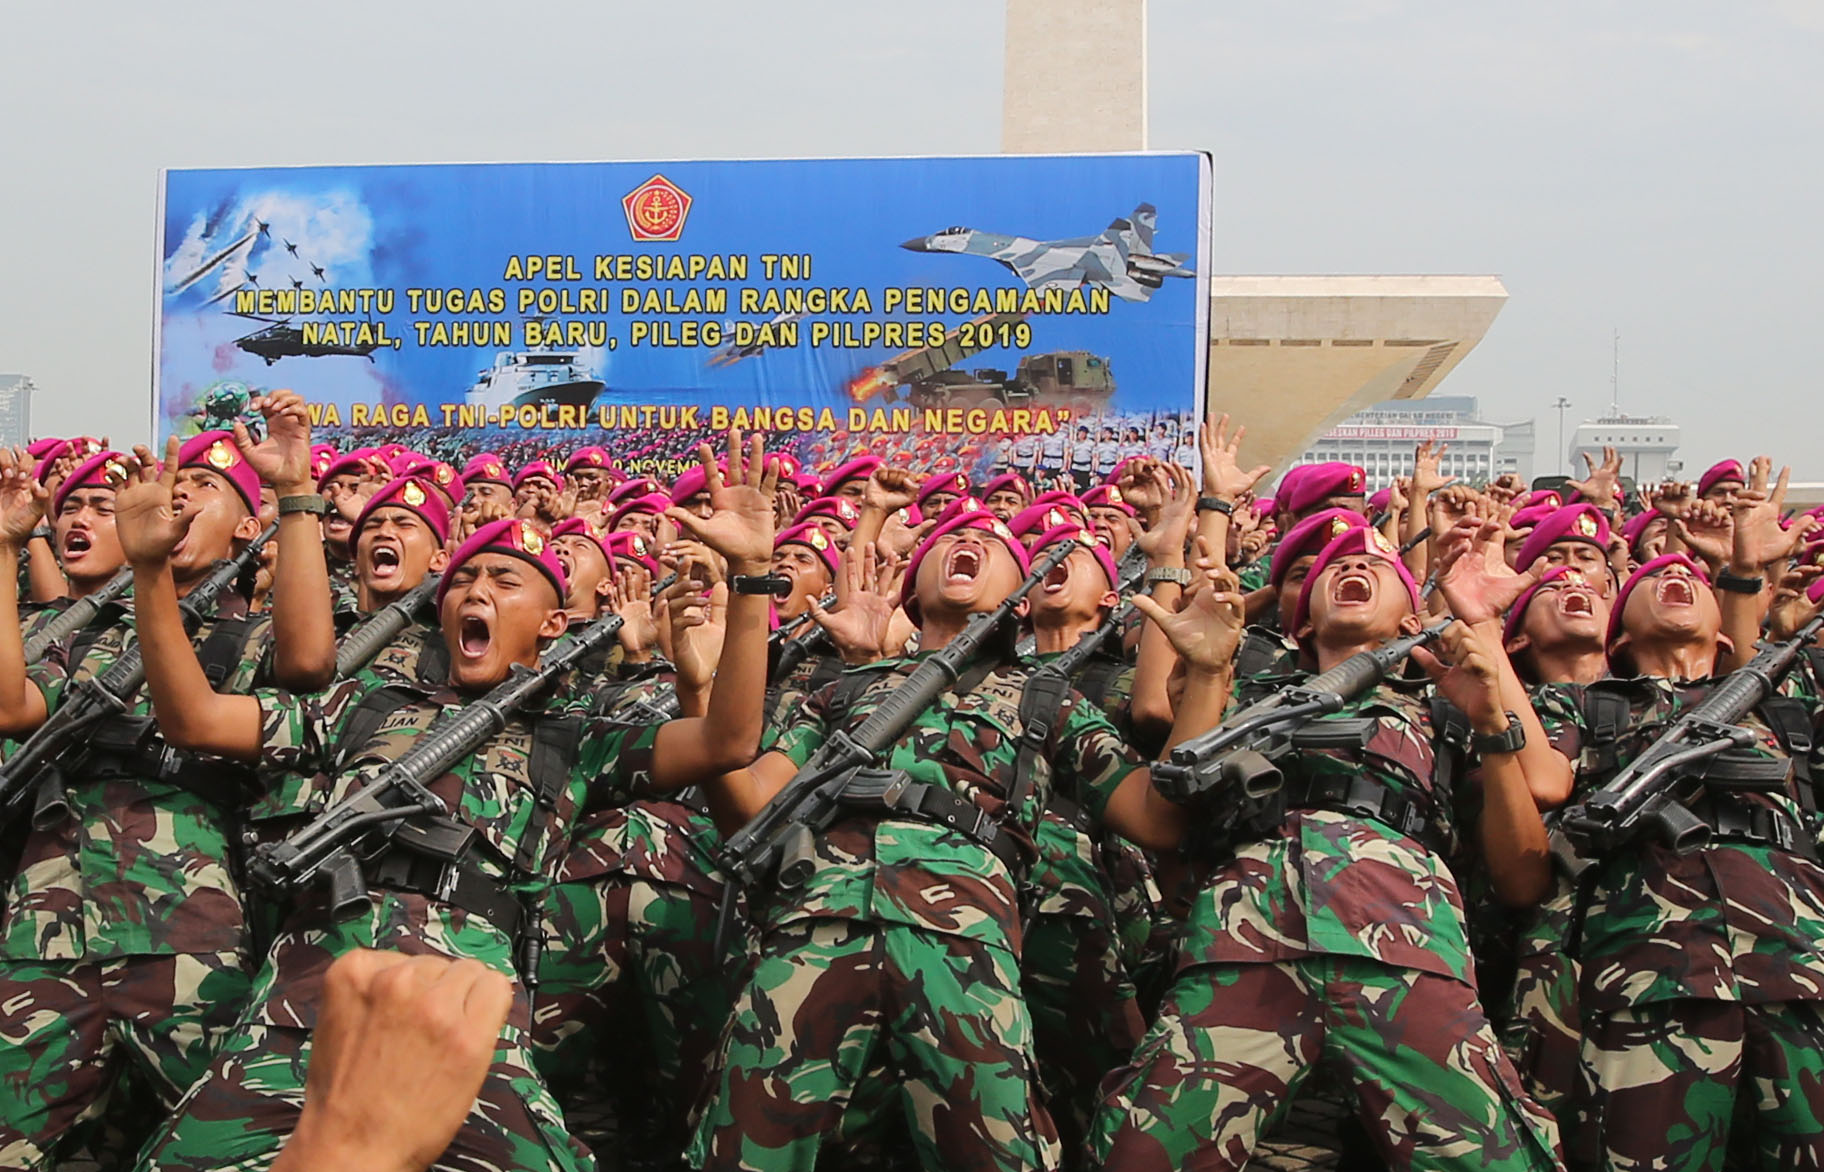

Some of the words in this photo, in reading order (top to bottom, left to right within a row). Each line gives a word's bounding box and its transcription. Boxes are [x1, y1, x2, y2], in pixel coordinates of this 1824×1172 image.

[505, 255, 580, 280] APEL
[595, 254, 748, 280] KESIAPAN
[762, 253, 812, 280] TNI
[236, 288, 394, 314] MEMBANTU
[409, 288, 505, 314] TUGAS
[519, 288, 608, 314] POLRI
[622, 288, 726, 313] DALAM
[741, 287, 871, 314] RANGKA
[885, 287, 1109, 314] PENGAMANAN
[302, 321, 402, 349] NATAL,
[415, 321, 512, 346] TAHUN
[524, 321, 617, 350] BARU,
[632, 320, 721, 347] PILEG
[735, 321, 798, 347] DAN
[812, 321, 946, 348] PILPRES
[959, 322, 1031, 348] 2019
[351, 403, 430, 428] RAGA
[441, 404, 587, 429] TNI-POLRI
[598, 405, 699, 430] UNTUK
[710, 406, 837, 432] BANGSA
[848, 407, 911, 433] DAN
